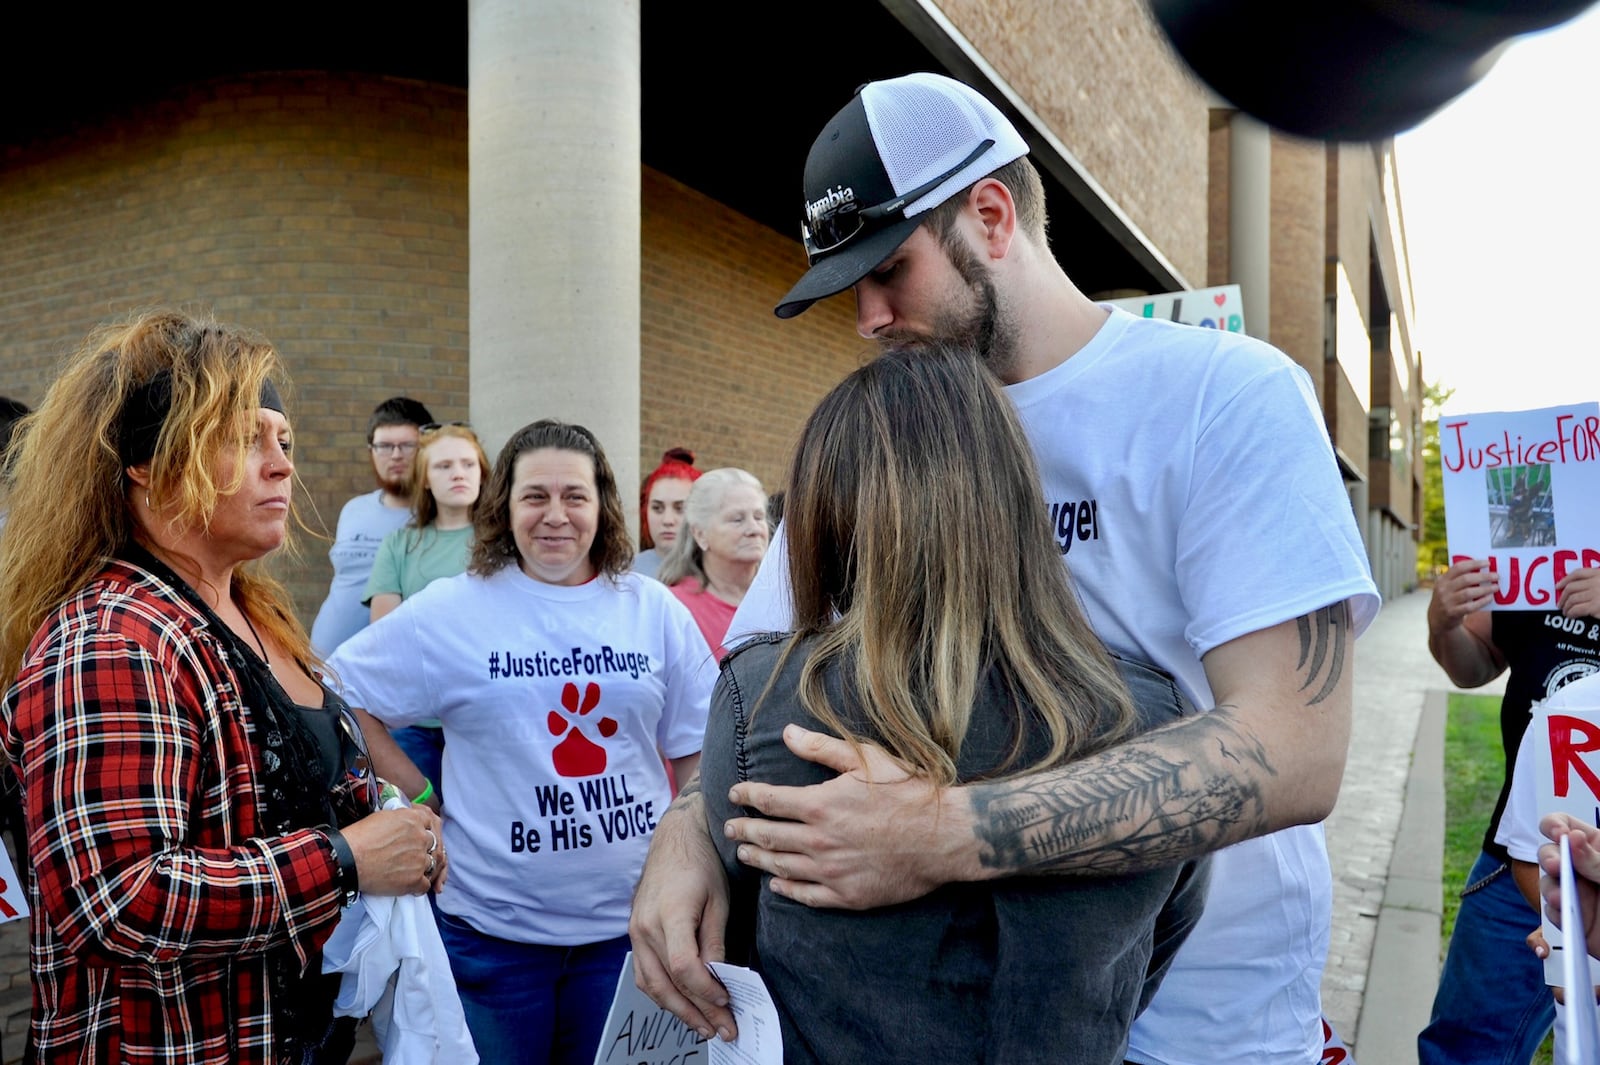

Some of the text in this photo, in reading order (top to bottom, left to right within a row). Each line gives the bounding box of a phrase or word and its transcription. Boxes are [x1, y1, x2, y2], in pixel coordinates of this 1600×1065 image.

[805, 185, 855, 222] lumbia
[1544, 614, 1599, 641] LOUD &
[489, 645, 651, 680] #JusticeForRuger
[535, 774, 634, 817] We WILL
[511, 801, 656, 853] Be His VOICE
